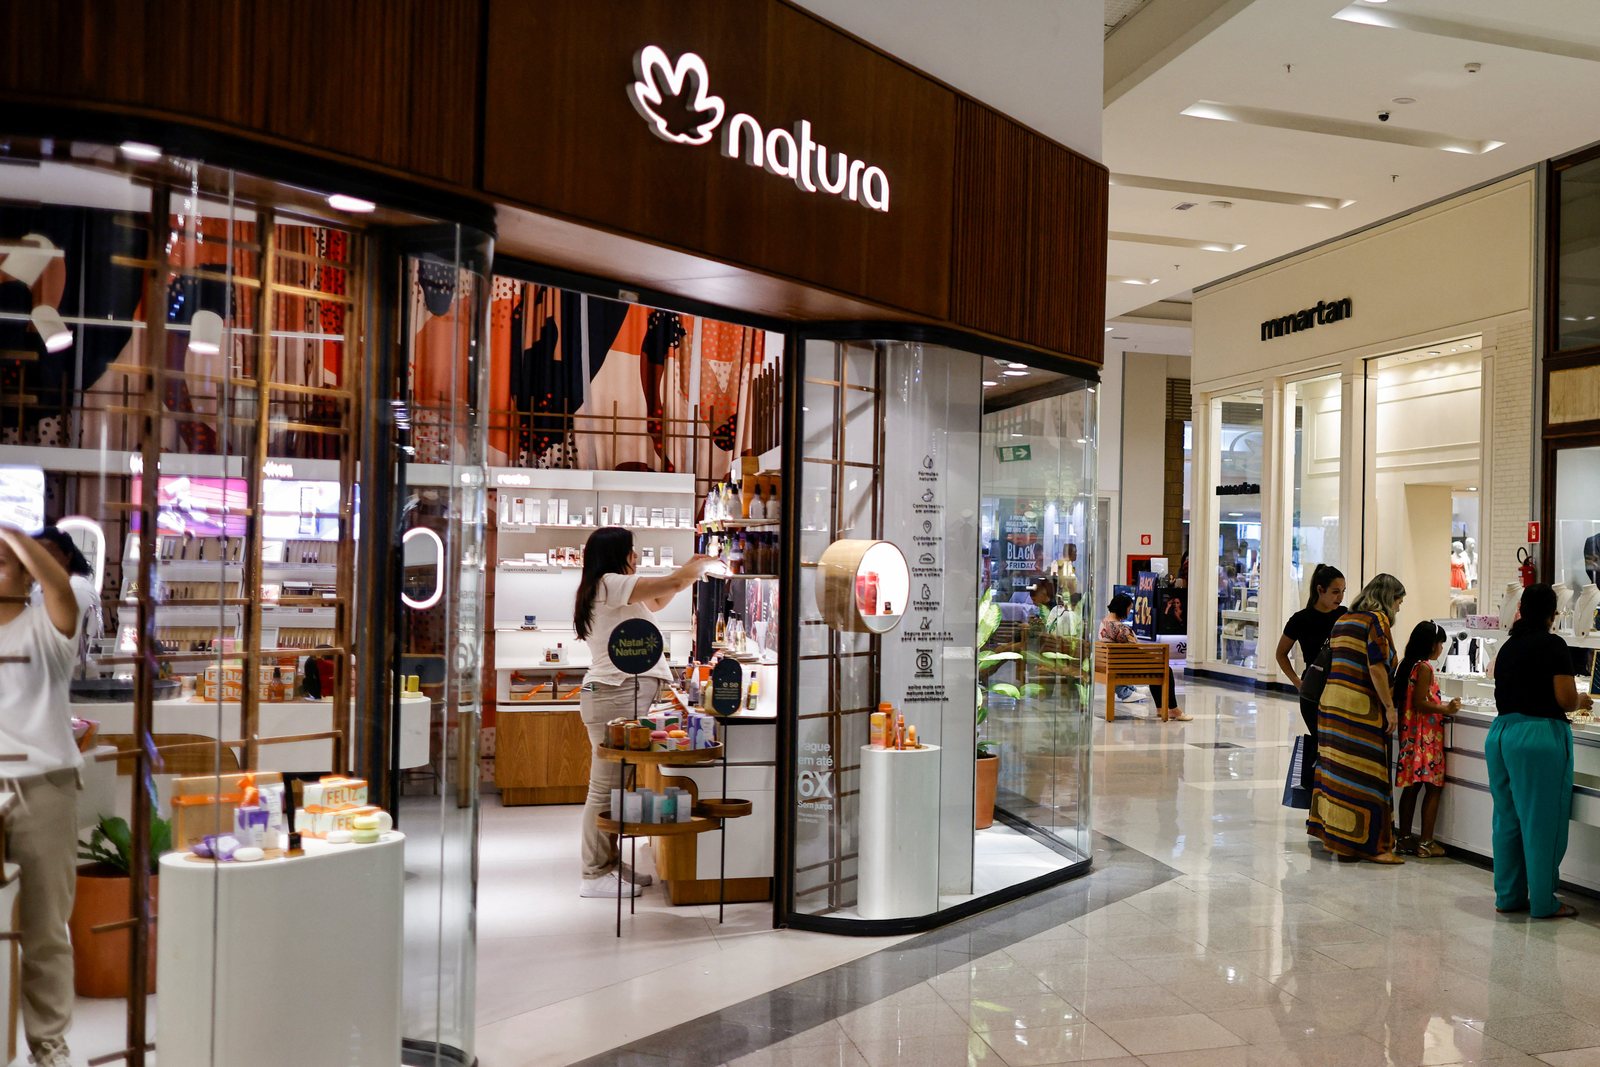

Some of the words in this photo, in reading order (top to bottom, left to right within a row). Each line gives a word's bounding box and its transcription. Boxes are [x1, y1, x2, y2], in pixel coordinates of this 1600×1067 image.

[724, 113, 889, 212] natura
[1261, 298, 1352, 341] mmartan
[1007, 541, 1036, 560] BLACK
[619, 637, 644, 647] Natal
[615, 647, 648, 657] Natura
[815, 755, 833, 767] até
[798, 770, 833, 798] 6X
[326, 787, 358, 805] FELIZ
[798, 800, 814, 809] Sem
